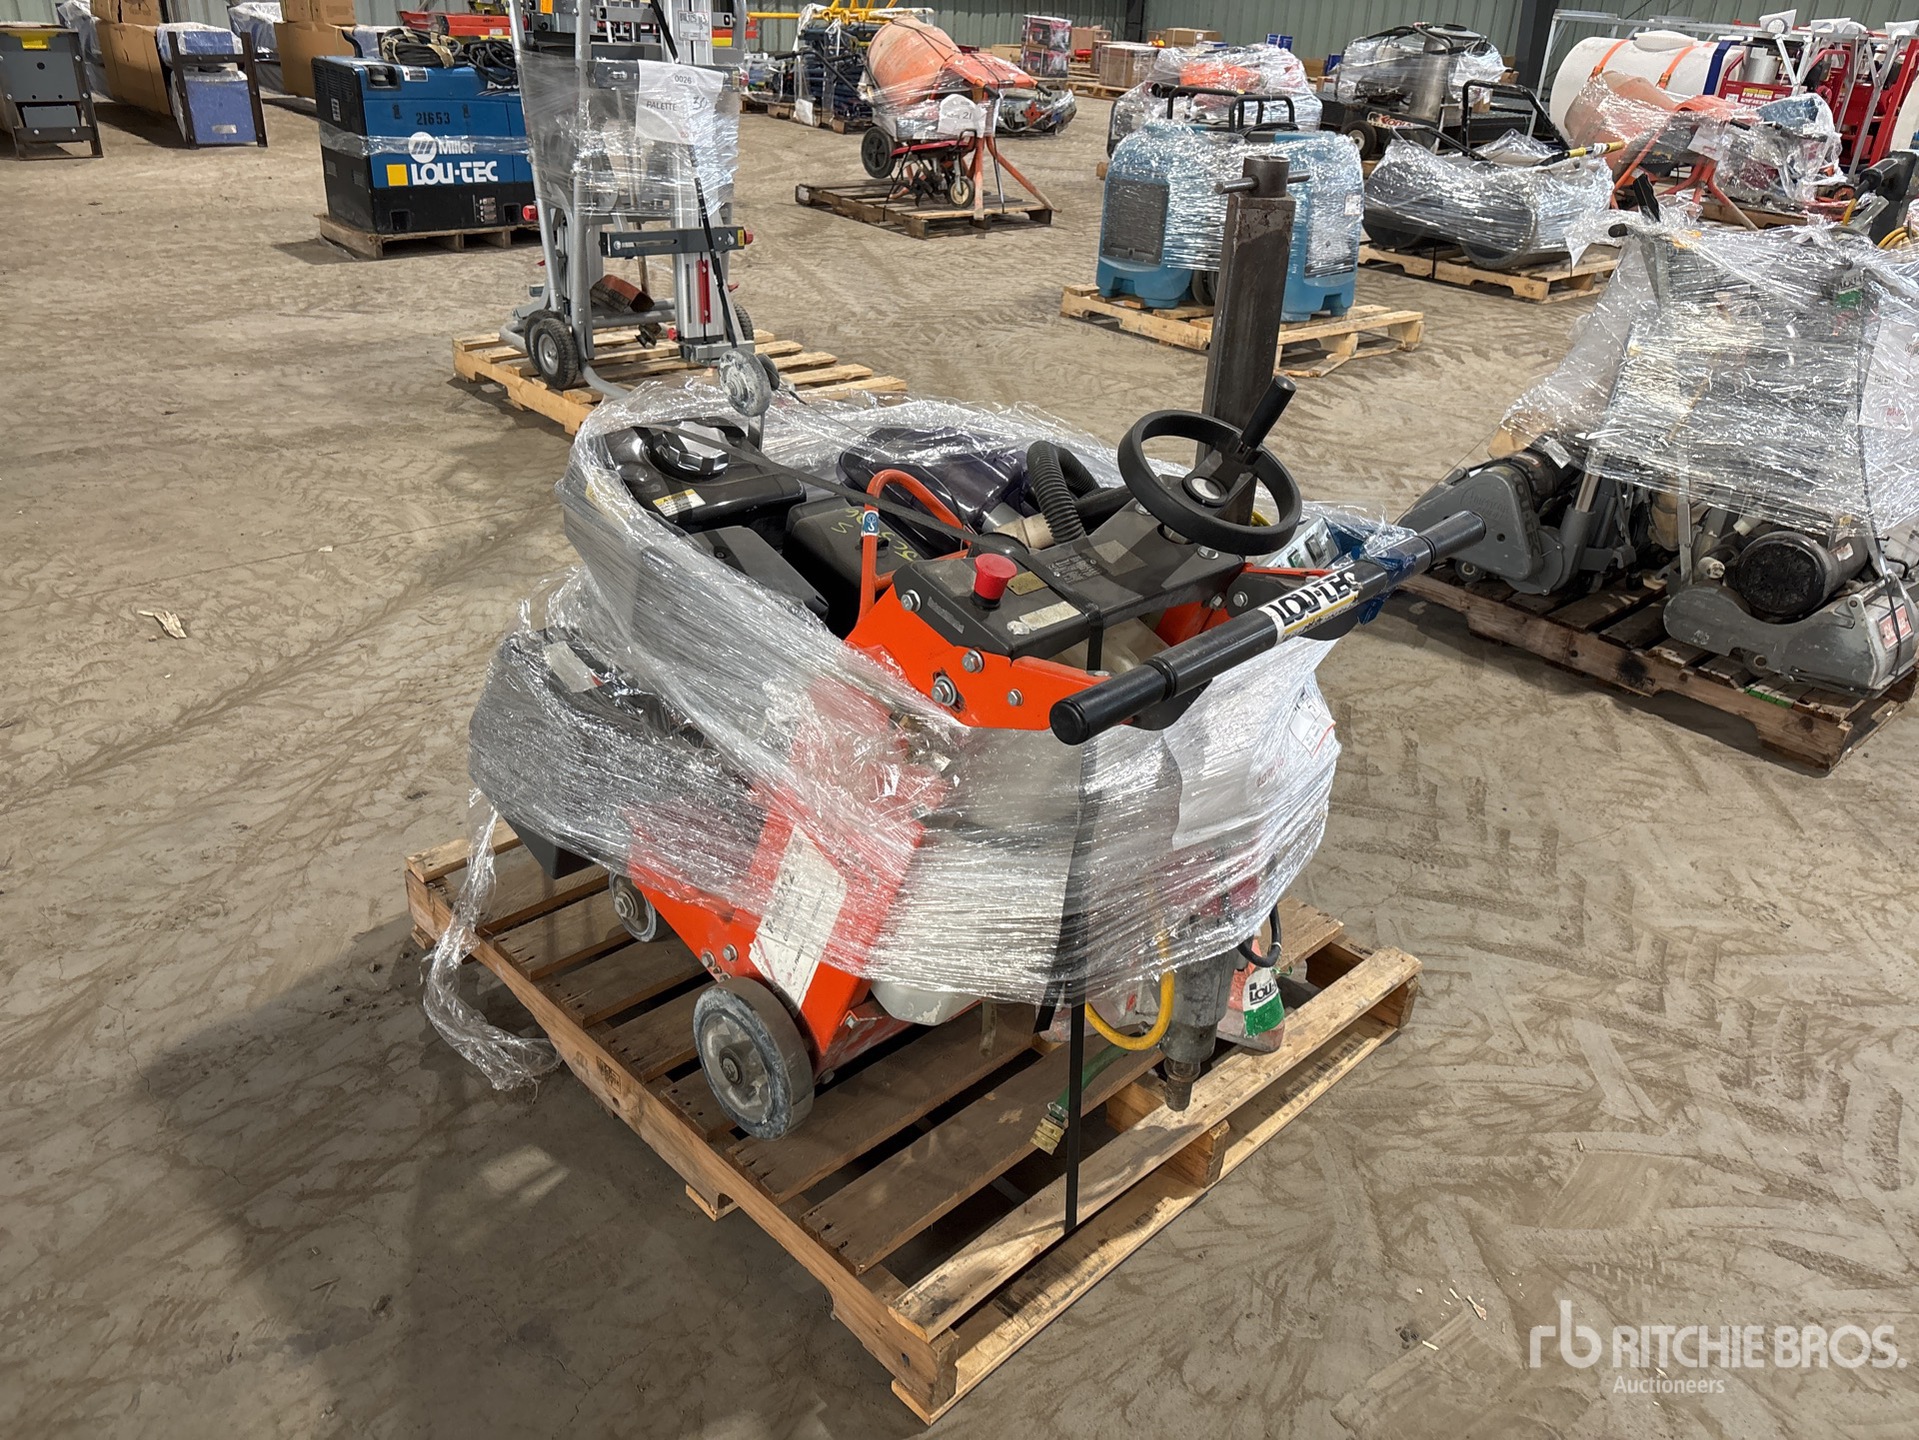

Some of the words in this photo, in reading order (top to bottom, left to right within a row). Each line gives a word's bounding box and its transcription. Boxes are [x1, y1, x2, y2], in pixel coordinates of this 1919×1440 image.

[645, 100, 678, 112] PALETTE
[415, 111, 452, 126] 21653
[438, 138, 477, 155] Miller
[410, 160, 499, 186] LOU-TEC
